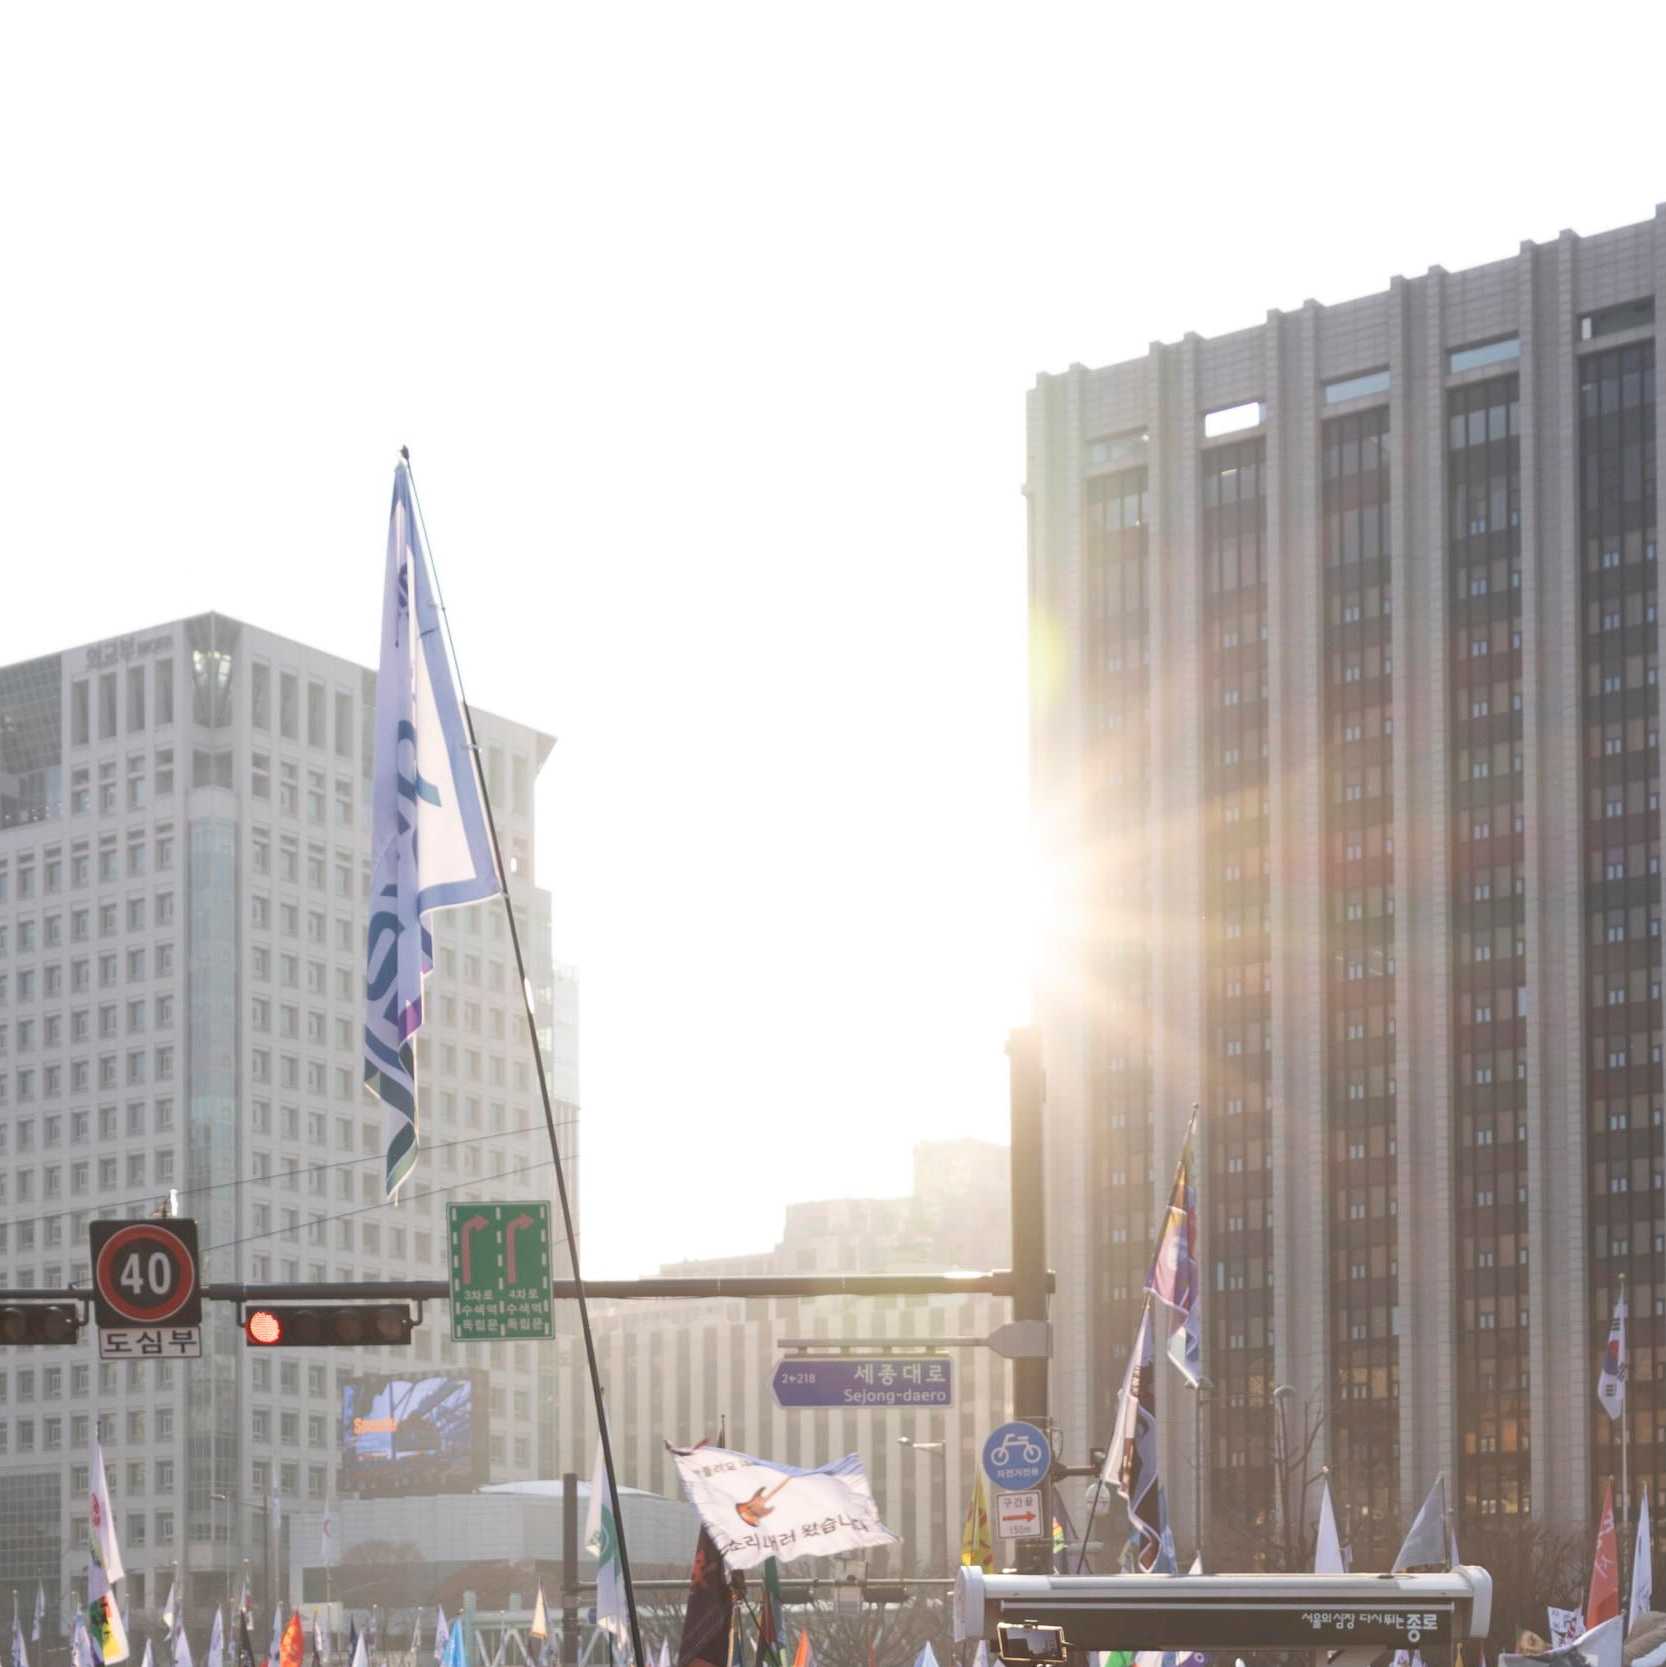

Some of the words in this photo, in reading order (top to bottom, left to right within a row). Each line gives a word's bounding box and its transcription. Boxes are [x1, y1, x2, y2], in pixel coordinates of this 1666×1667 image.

[119, 1251, 171, 1296] 40
[463, 1289, 493, 1301] 3차로
[508, 1288, 539, 1300] 4차로
[103, 1330, 199, 1356] 도심부
[852, 1362, 948, 1386] 세종대로
[843, 1387, 948, 1407] Sejong-daero
[996, 1466, 1039, 1479] 자전거전용
[1009, 1524, 1032, 1536] 150m
[1301, 1612, 1332, 1630] 서울의
[1333, 1612, 1356, 1630] 심장
[1359, 1612, 1383, 1624] 다시
[1384, 1613, 1405, 1630] 뛰는
[1406, 1613, 1438, 1643] 종로
